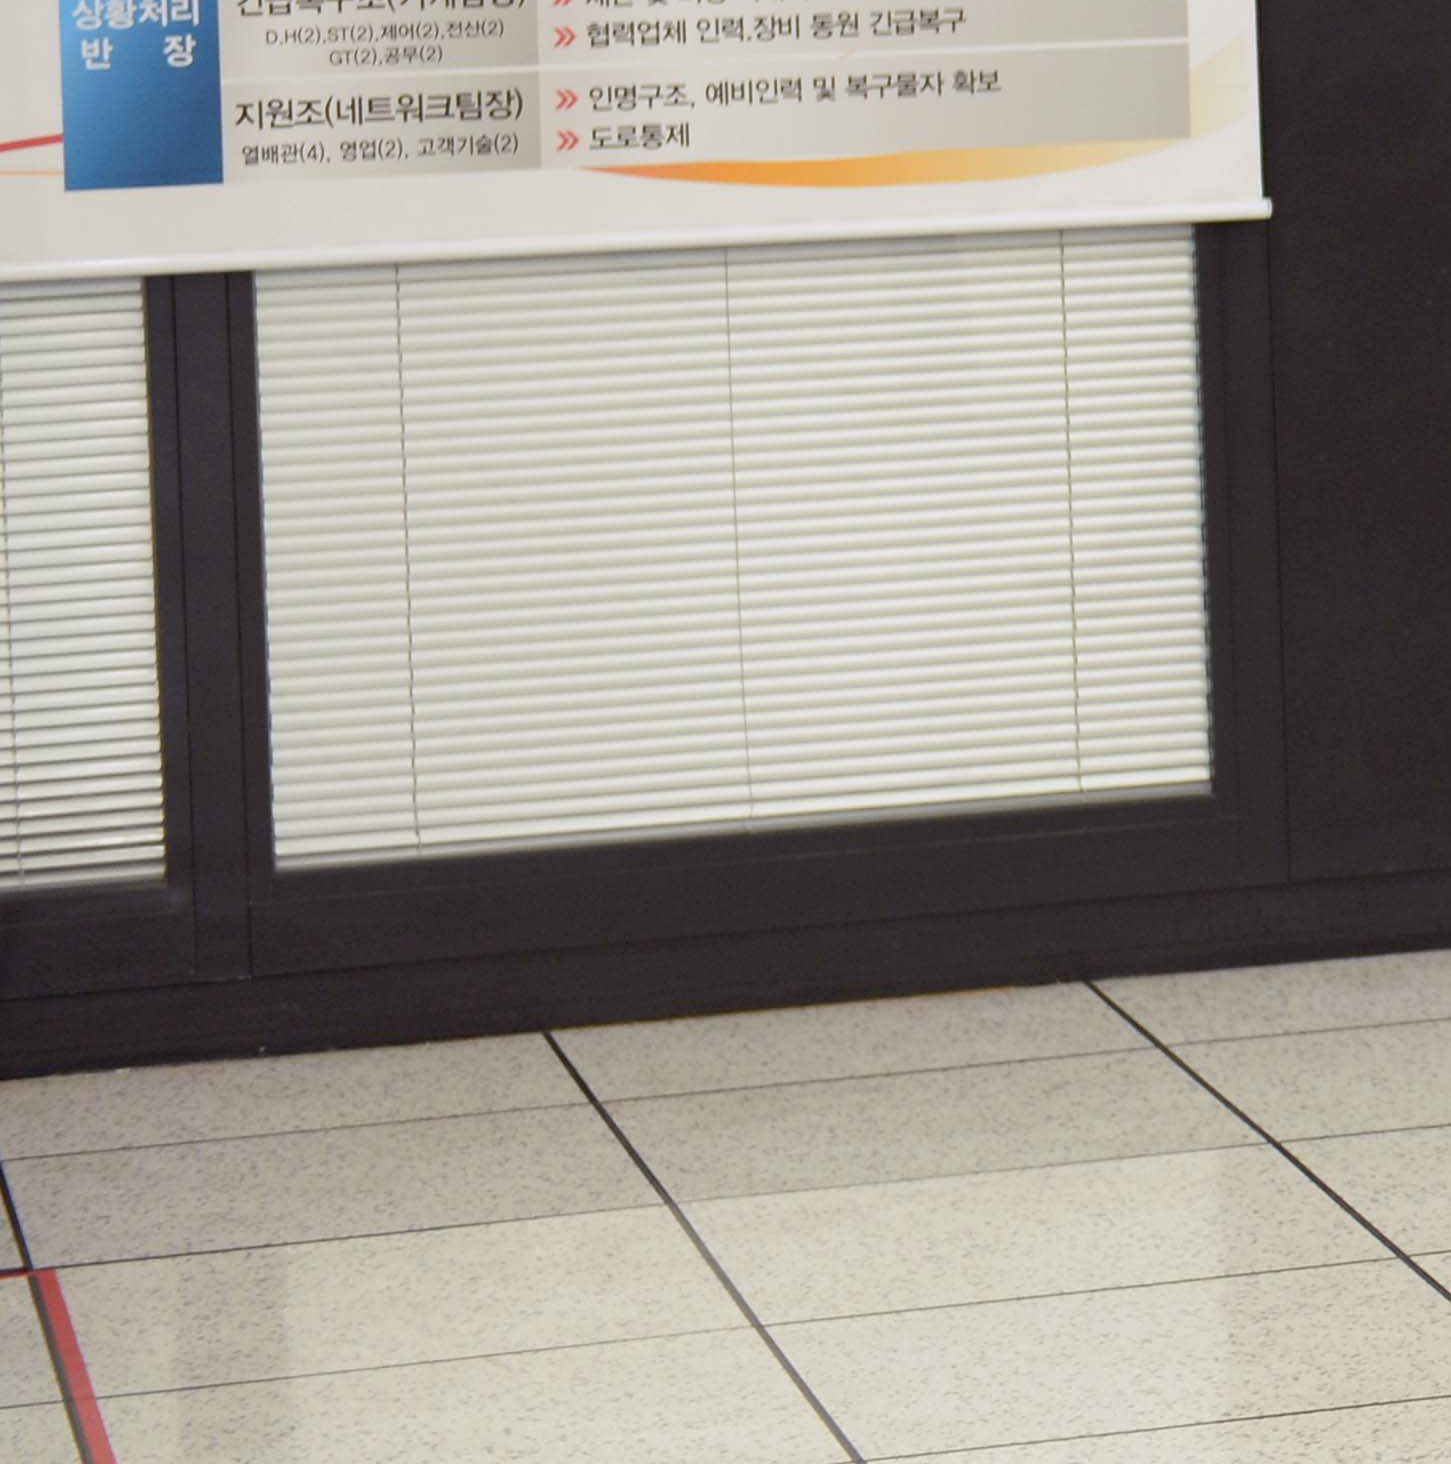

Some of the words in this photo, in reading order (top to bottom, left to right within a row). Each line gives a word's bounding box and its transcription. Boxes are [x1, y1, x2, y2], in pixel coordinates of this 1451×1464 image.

[587, 20, 686, 48] 협력업체
[811, 12, 858, 39] 동원
[871, 8, 966, 36] 긴급복구
[236, 88, 523, 130] 지원조(네트워크팀장)
[589, 85, 694, 111] 인명구조,
[706, 77, 802, 106] 예비인력
[813, 76, 835, 102] 및
[847, 71, 944, 99] 복구물자
[954, 69, 1000, 94] 확보
[590, 123, 689, 149] 도로통제
